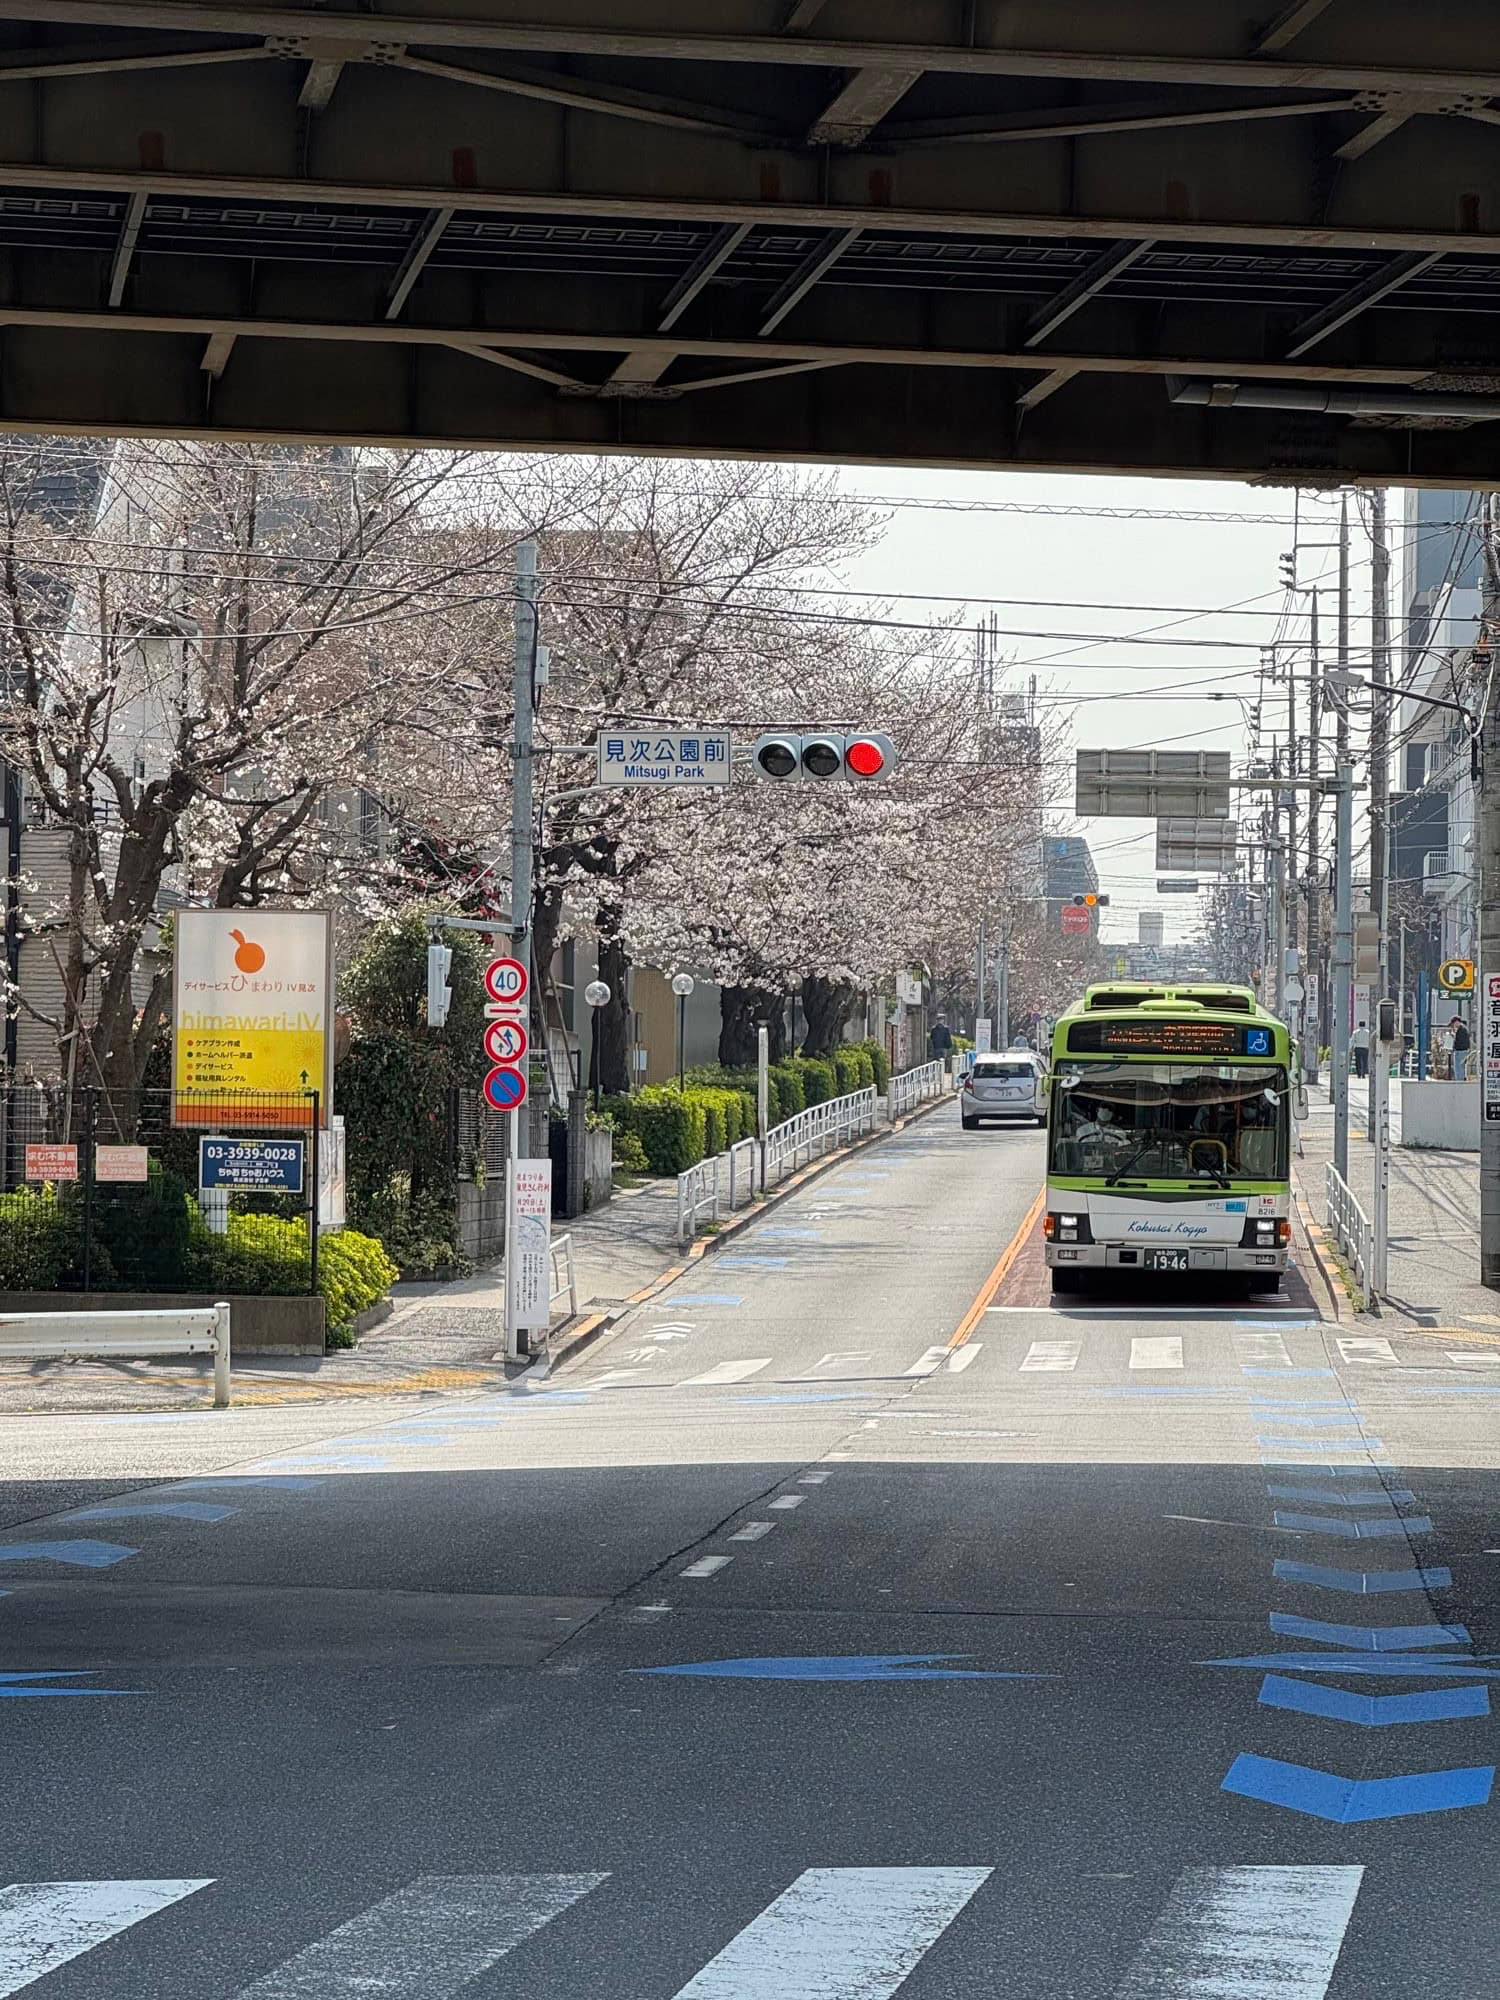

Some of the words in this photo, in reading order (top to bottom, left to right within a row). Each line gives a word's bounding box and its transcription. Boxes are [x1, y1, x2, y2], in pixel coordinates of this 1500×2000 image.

[606, 739, 725, 762] 見次公園前
[624, 765, 670, 780] Mitsugi
[675, 765, 704, 778] Park
[495, 971, 517, 990] 40
[1449, 966, 1463, 984] P
[181, 1009, 321, 1031] himawari-IV
[207, 1146, 296, 1160] 03-3939-0028
[1258, 1208, 1275, 1216] 8216
[1127, 1221, 1172, 1233] Kokusai
[1174, 1222, 1208, 1237] Kogyo
